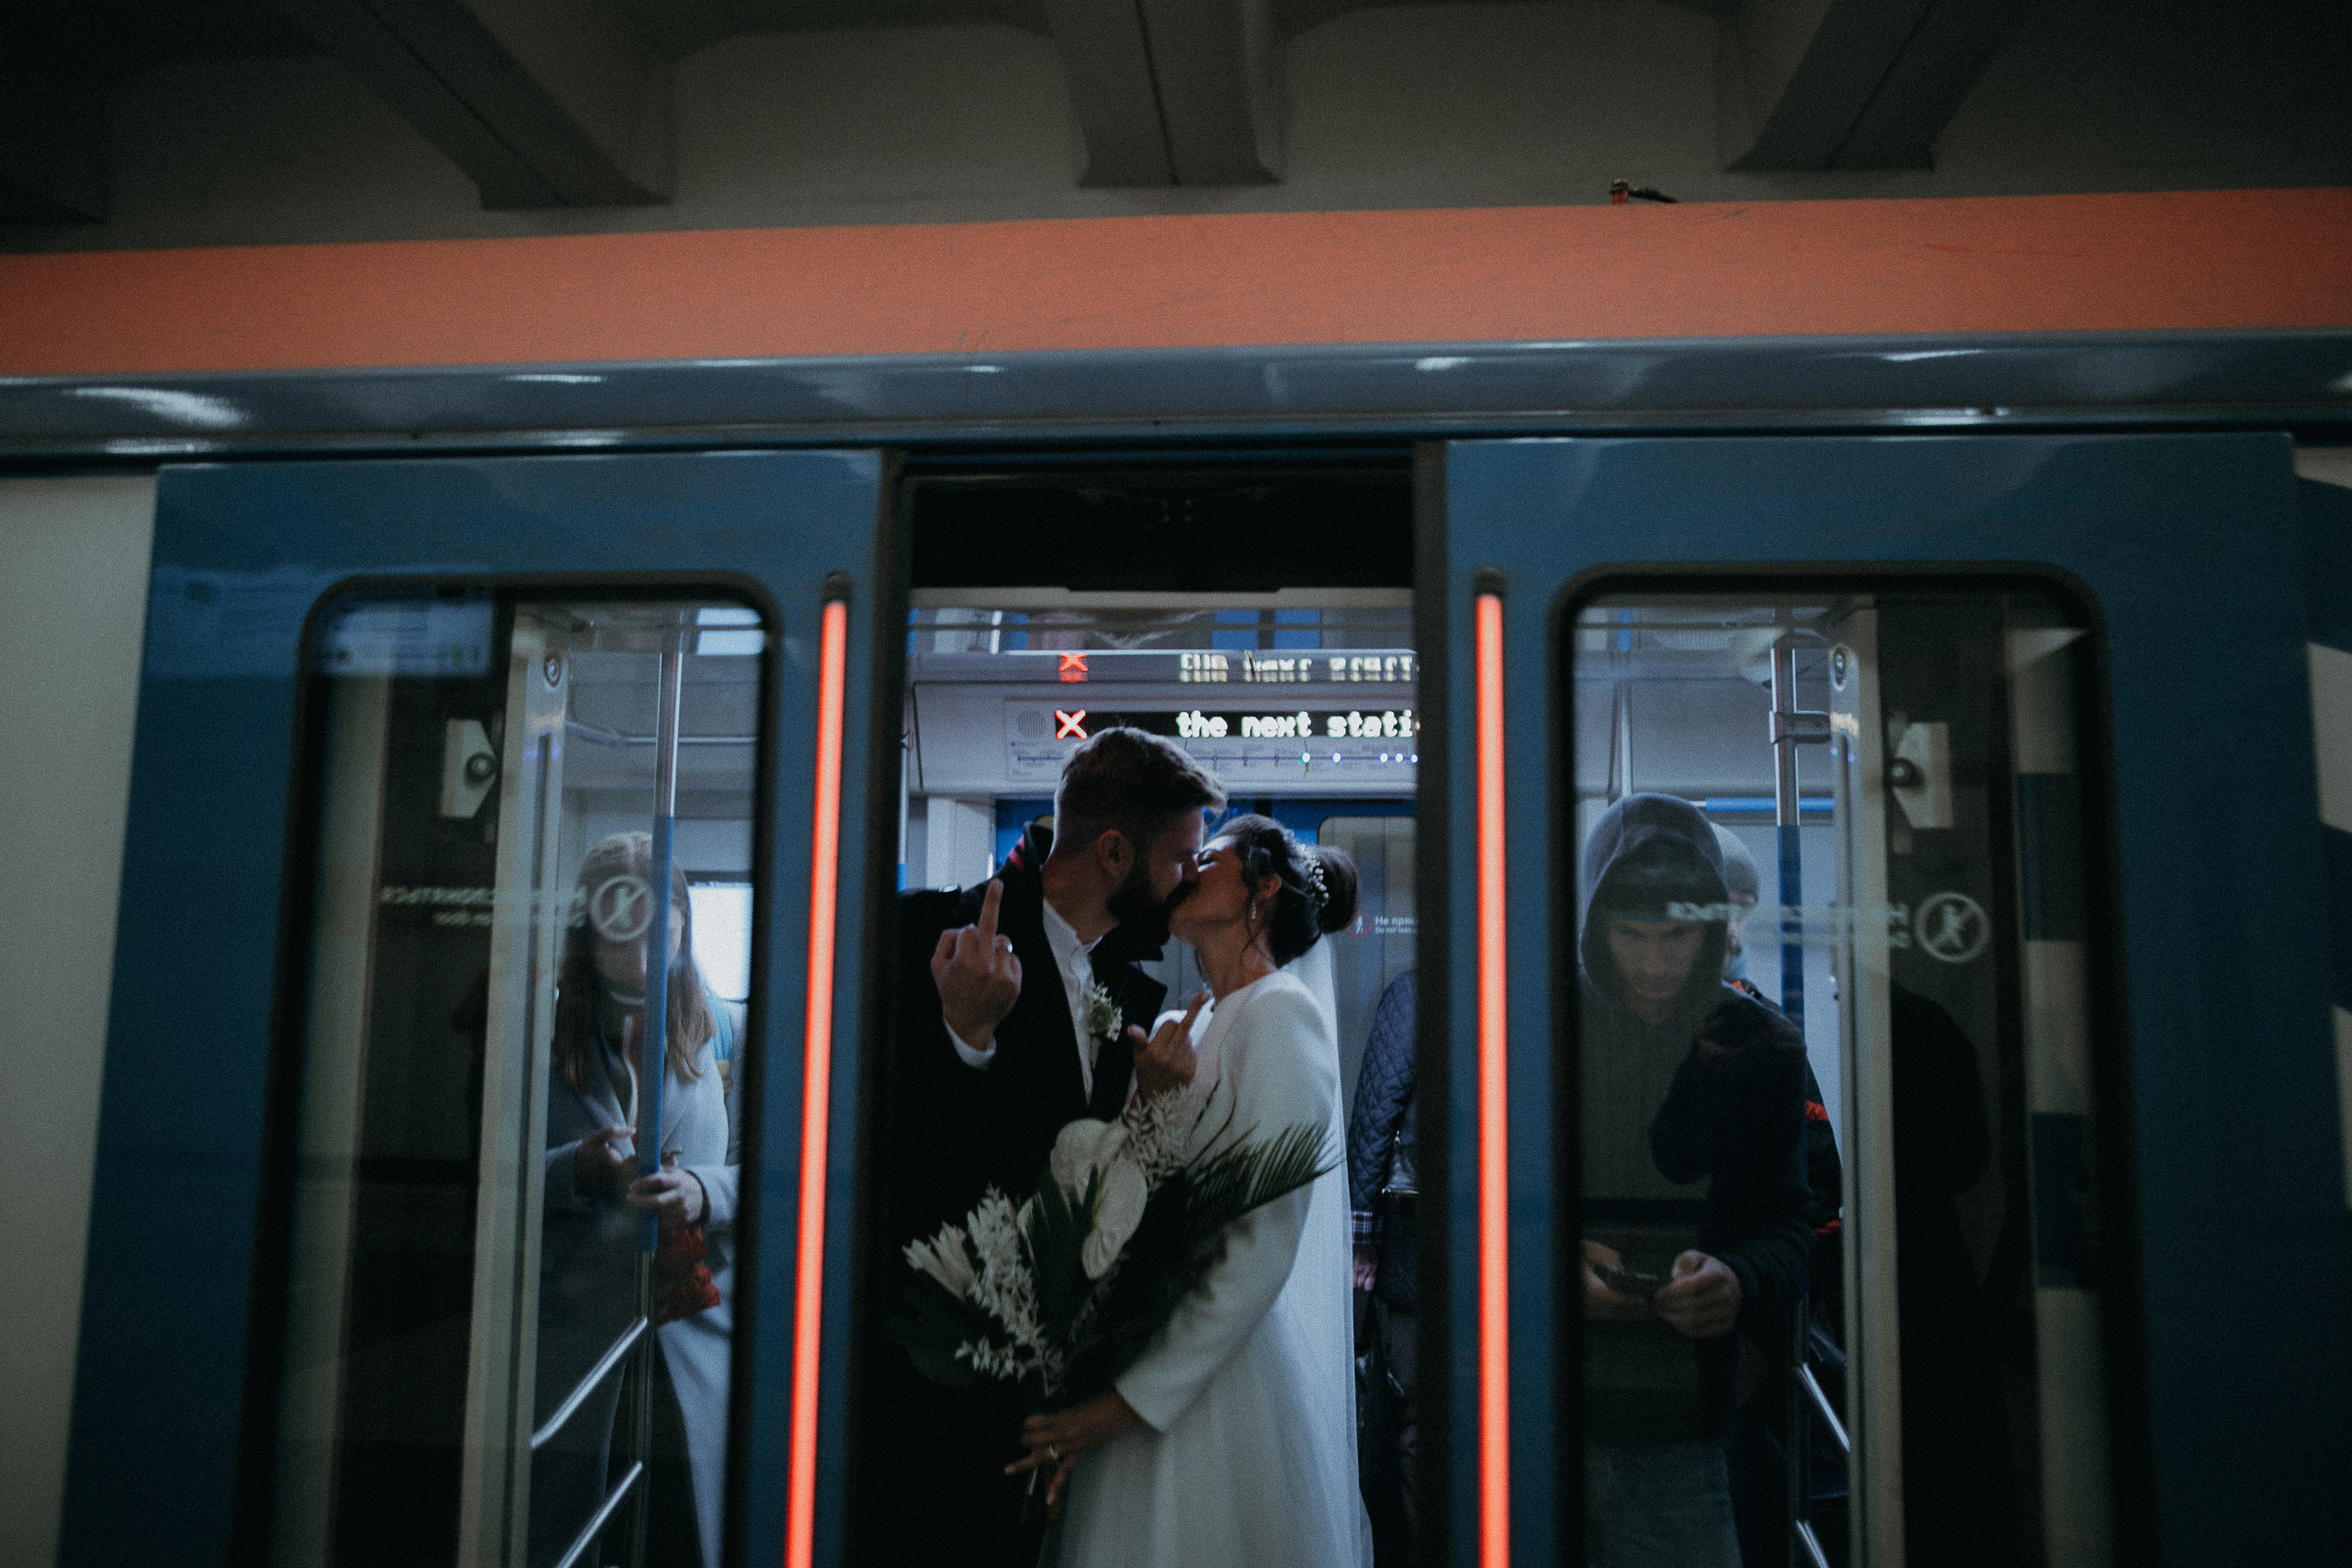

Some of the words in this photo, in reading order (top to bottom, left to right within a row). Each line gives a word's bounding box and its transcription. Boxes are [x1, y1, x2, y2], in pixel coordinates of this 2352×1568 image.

[1176, 710, 1228, 738] the
[1241, 711, 1312, 738] next
[1328, 709, 1420, 738] stati
